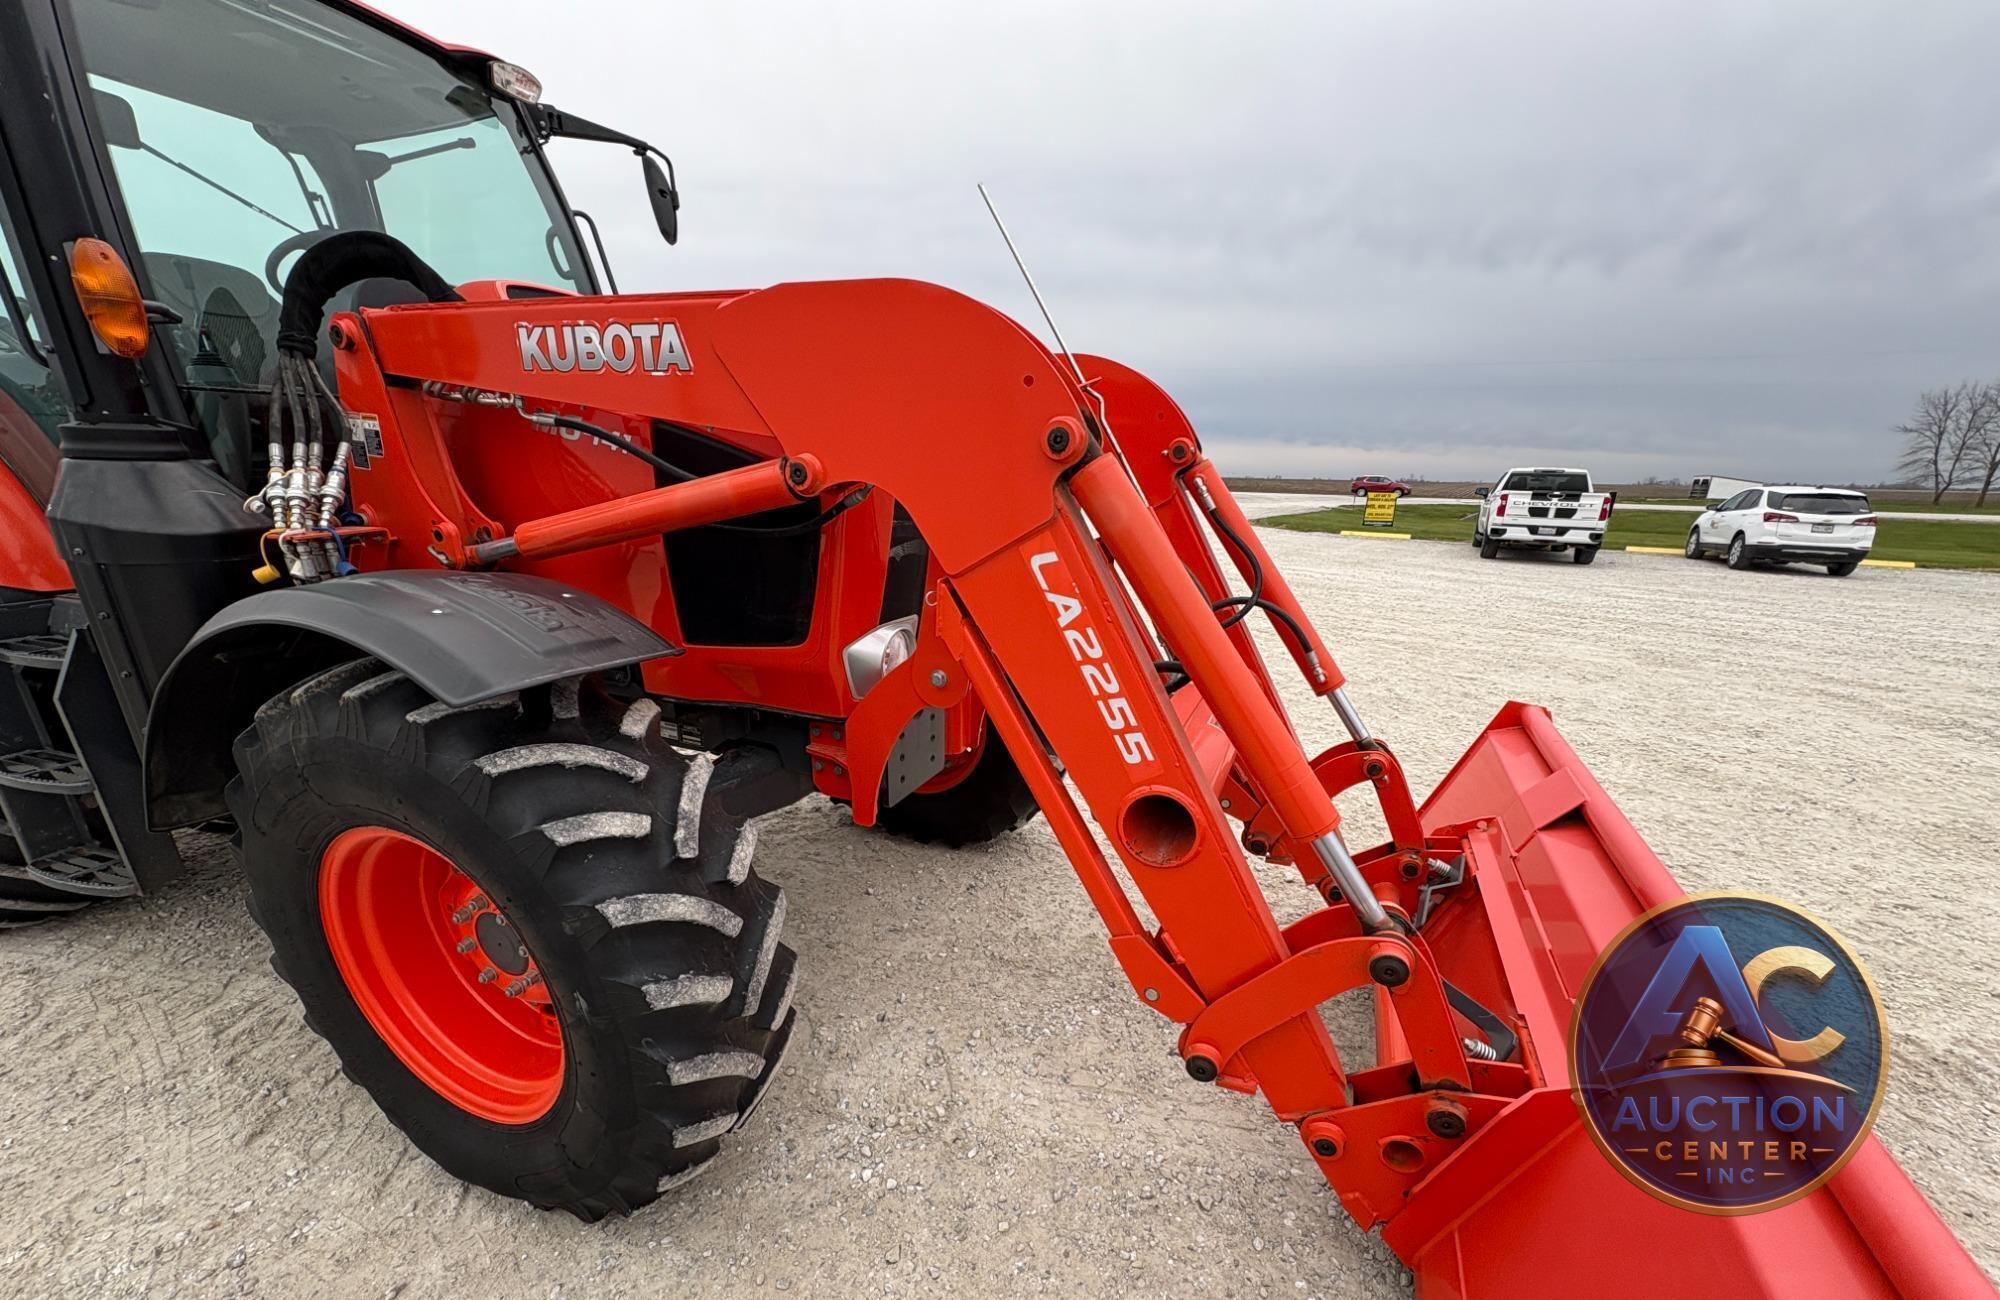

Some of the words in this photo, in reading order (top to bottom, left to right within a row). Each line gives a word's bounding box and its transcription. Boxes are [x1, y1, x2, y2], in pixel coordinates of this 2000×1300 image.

[516, 321, 692, 372] KUBOTA
[1512, 500, 1597, 508] CHEVROLET
[1030, 551, 1155, 764] LA2255
